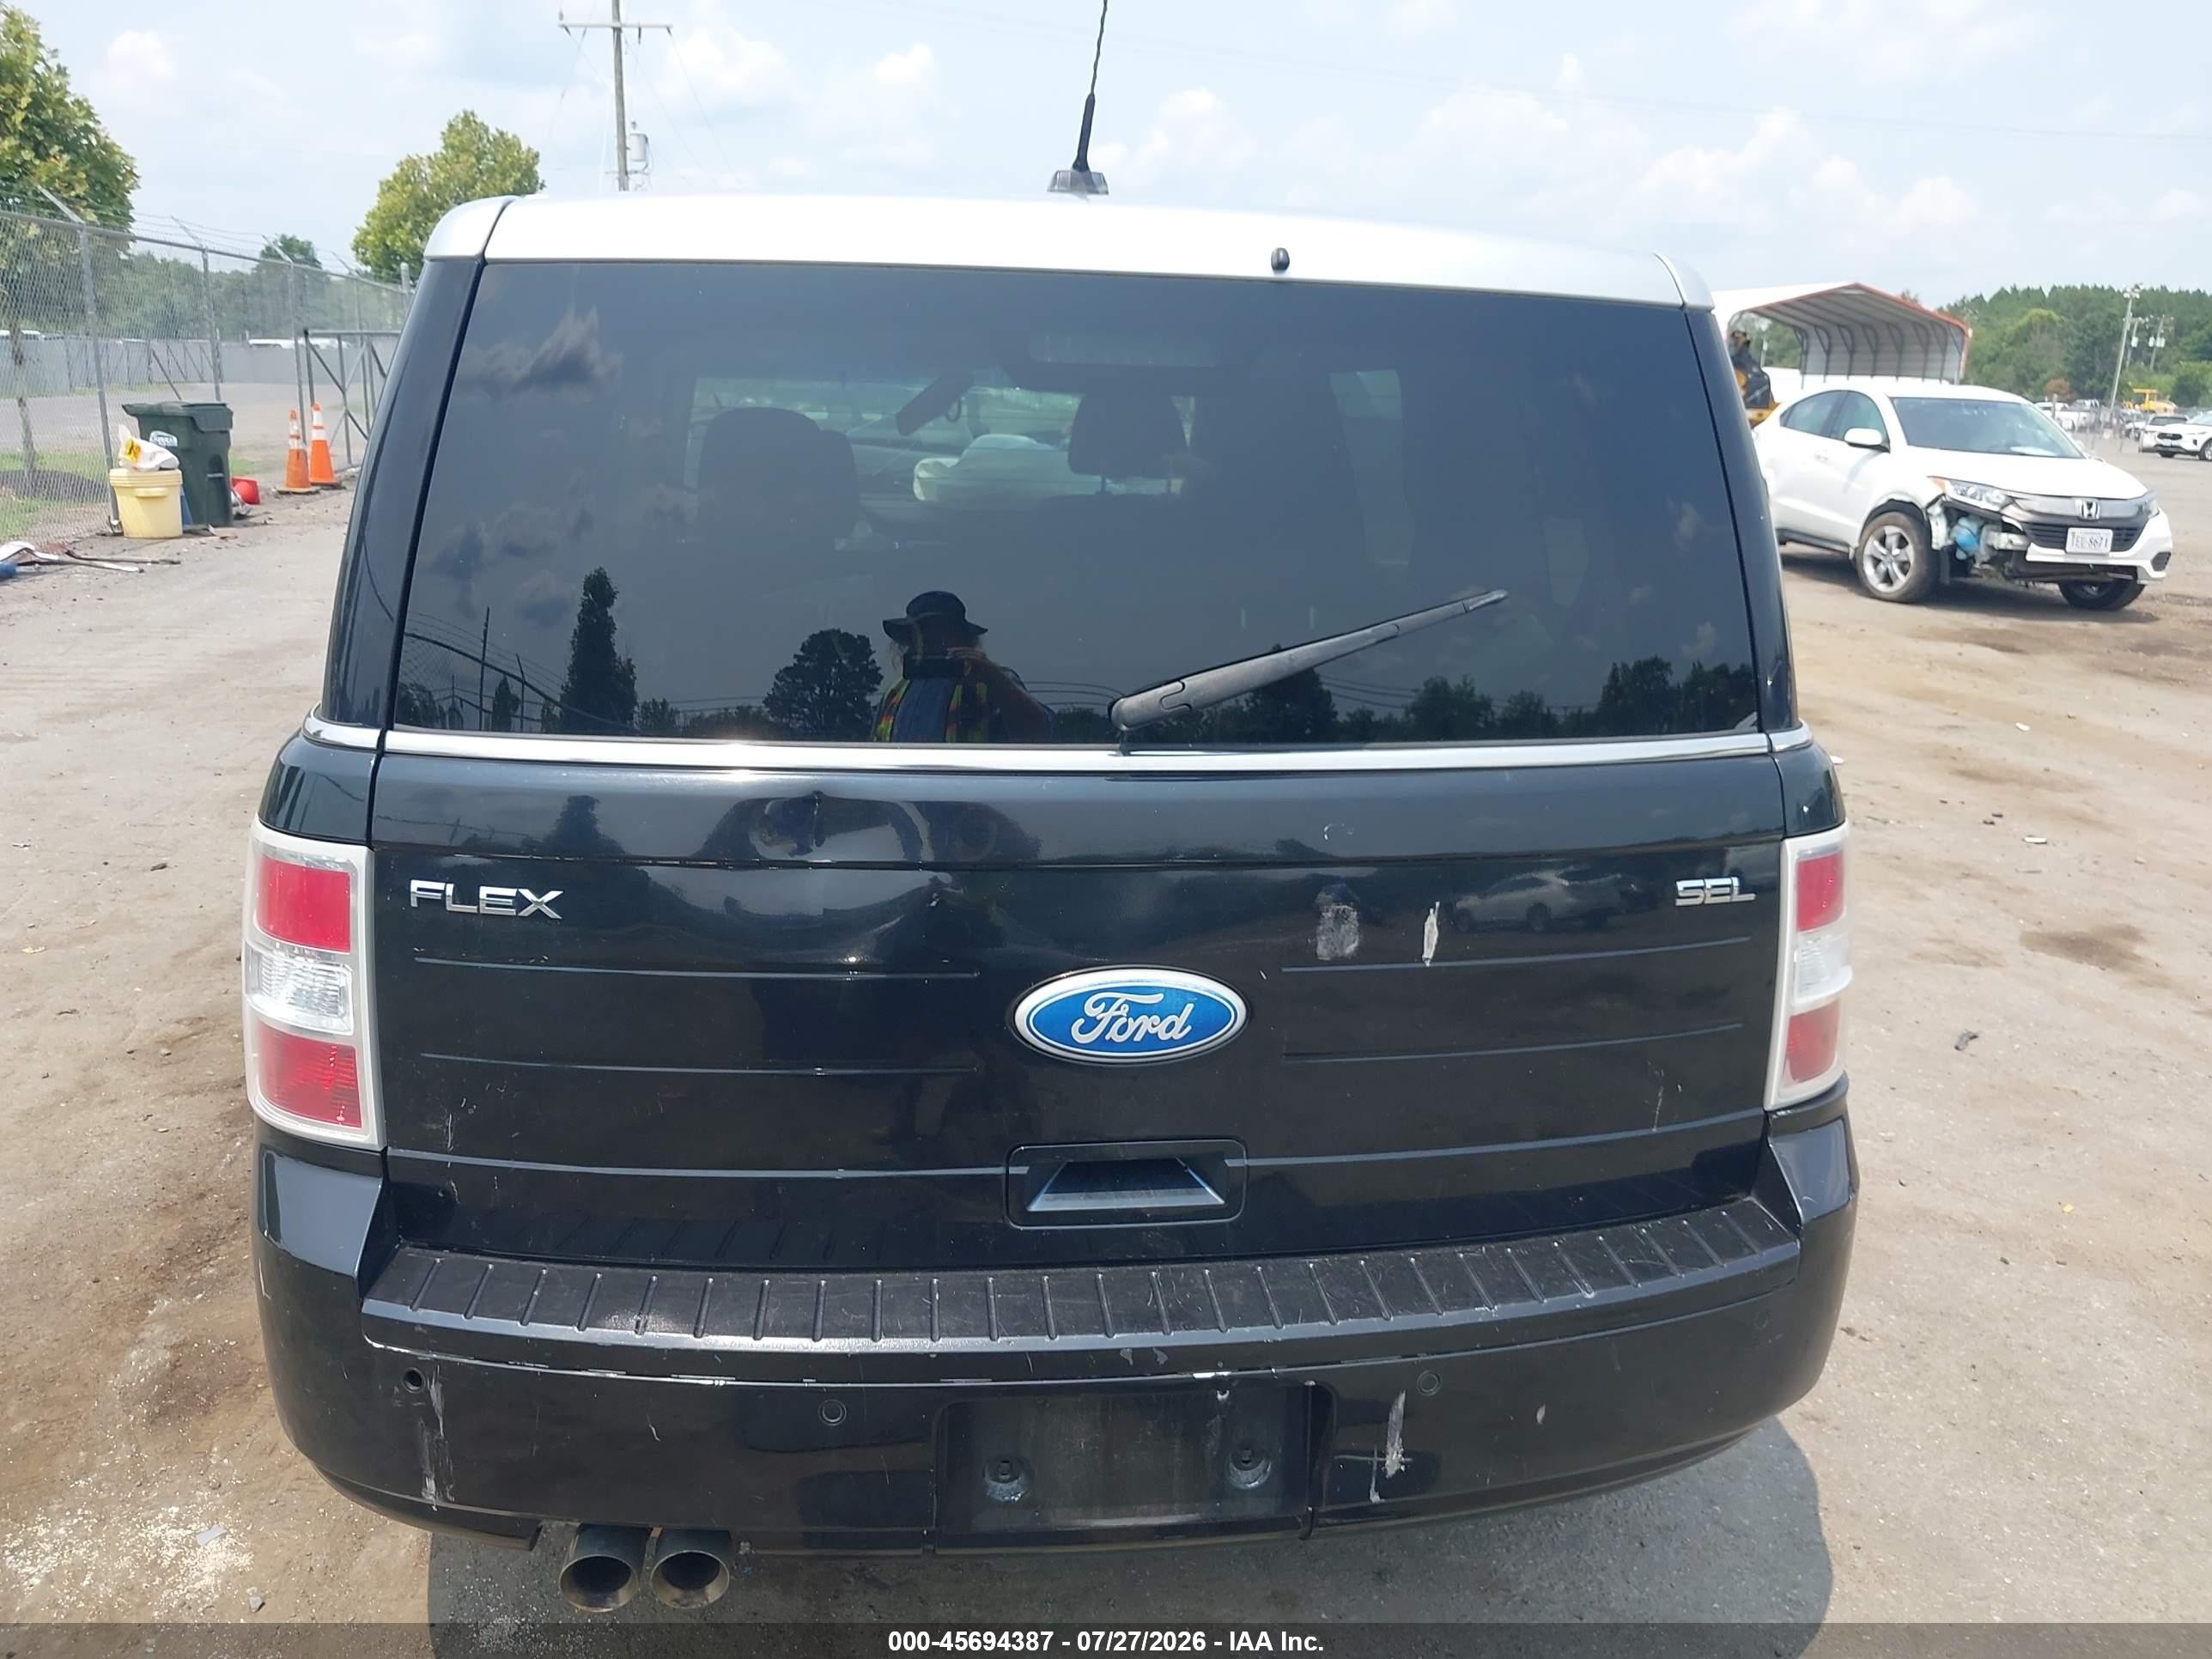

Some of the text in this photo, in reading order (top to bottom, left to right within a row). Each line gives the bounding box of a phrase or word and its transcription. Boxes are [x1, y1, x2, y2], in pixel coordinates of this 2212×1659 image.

[410, 879, 564, 920] FLEX
[1674, 876, 1757, 907] SEL
[1071, 991, 1195, 1044] Ford
